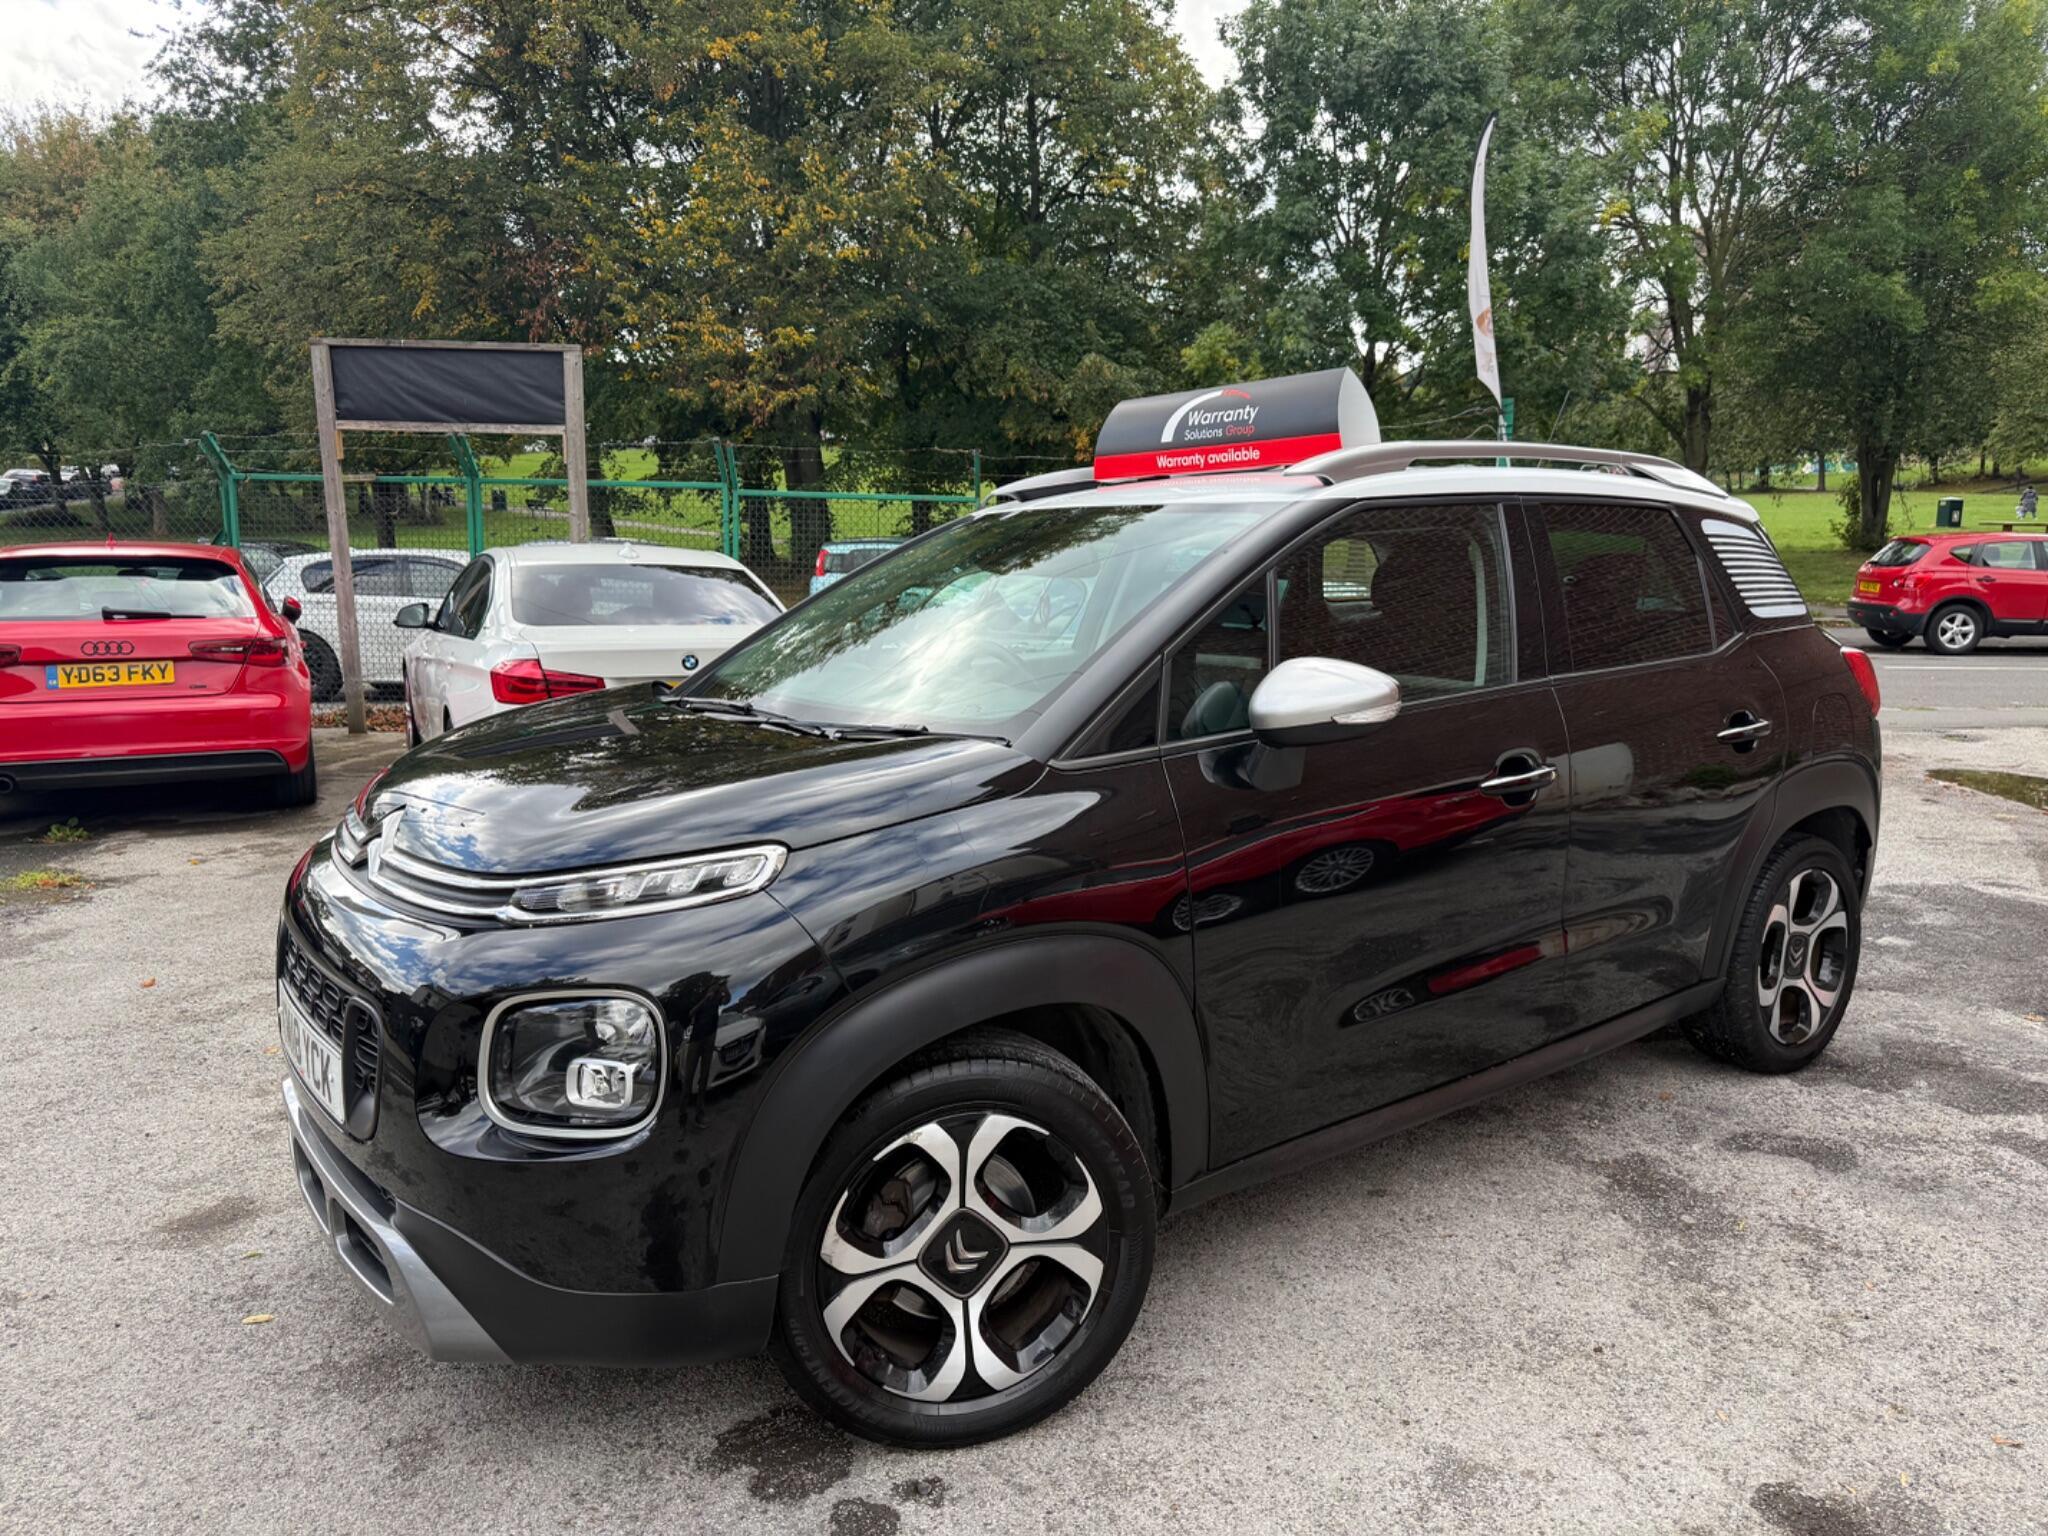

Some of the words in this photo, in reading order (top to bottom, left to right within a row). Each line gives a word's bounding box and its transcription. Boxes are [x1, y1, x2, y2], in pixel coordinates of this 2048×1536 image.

[1188, 405, 1259, 426] Warranty
[1184, 427, 1223, 441] Solutions
[1225, 424, 1255, 437] Group
[1156, 453, 1206, 468] Warranty
[1207, 446, 1260, 464] available
[61, 664, 121, 684] YD63
[127, 663, 169, 681] FKY
[302, 1028, 332, 1104] YCK
